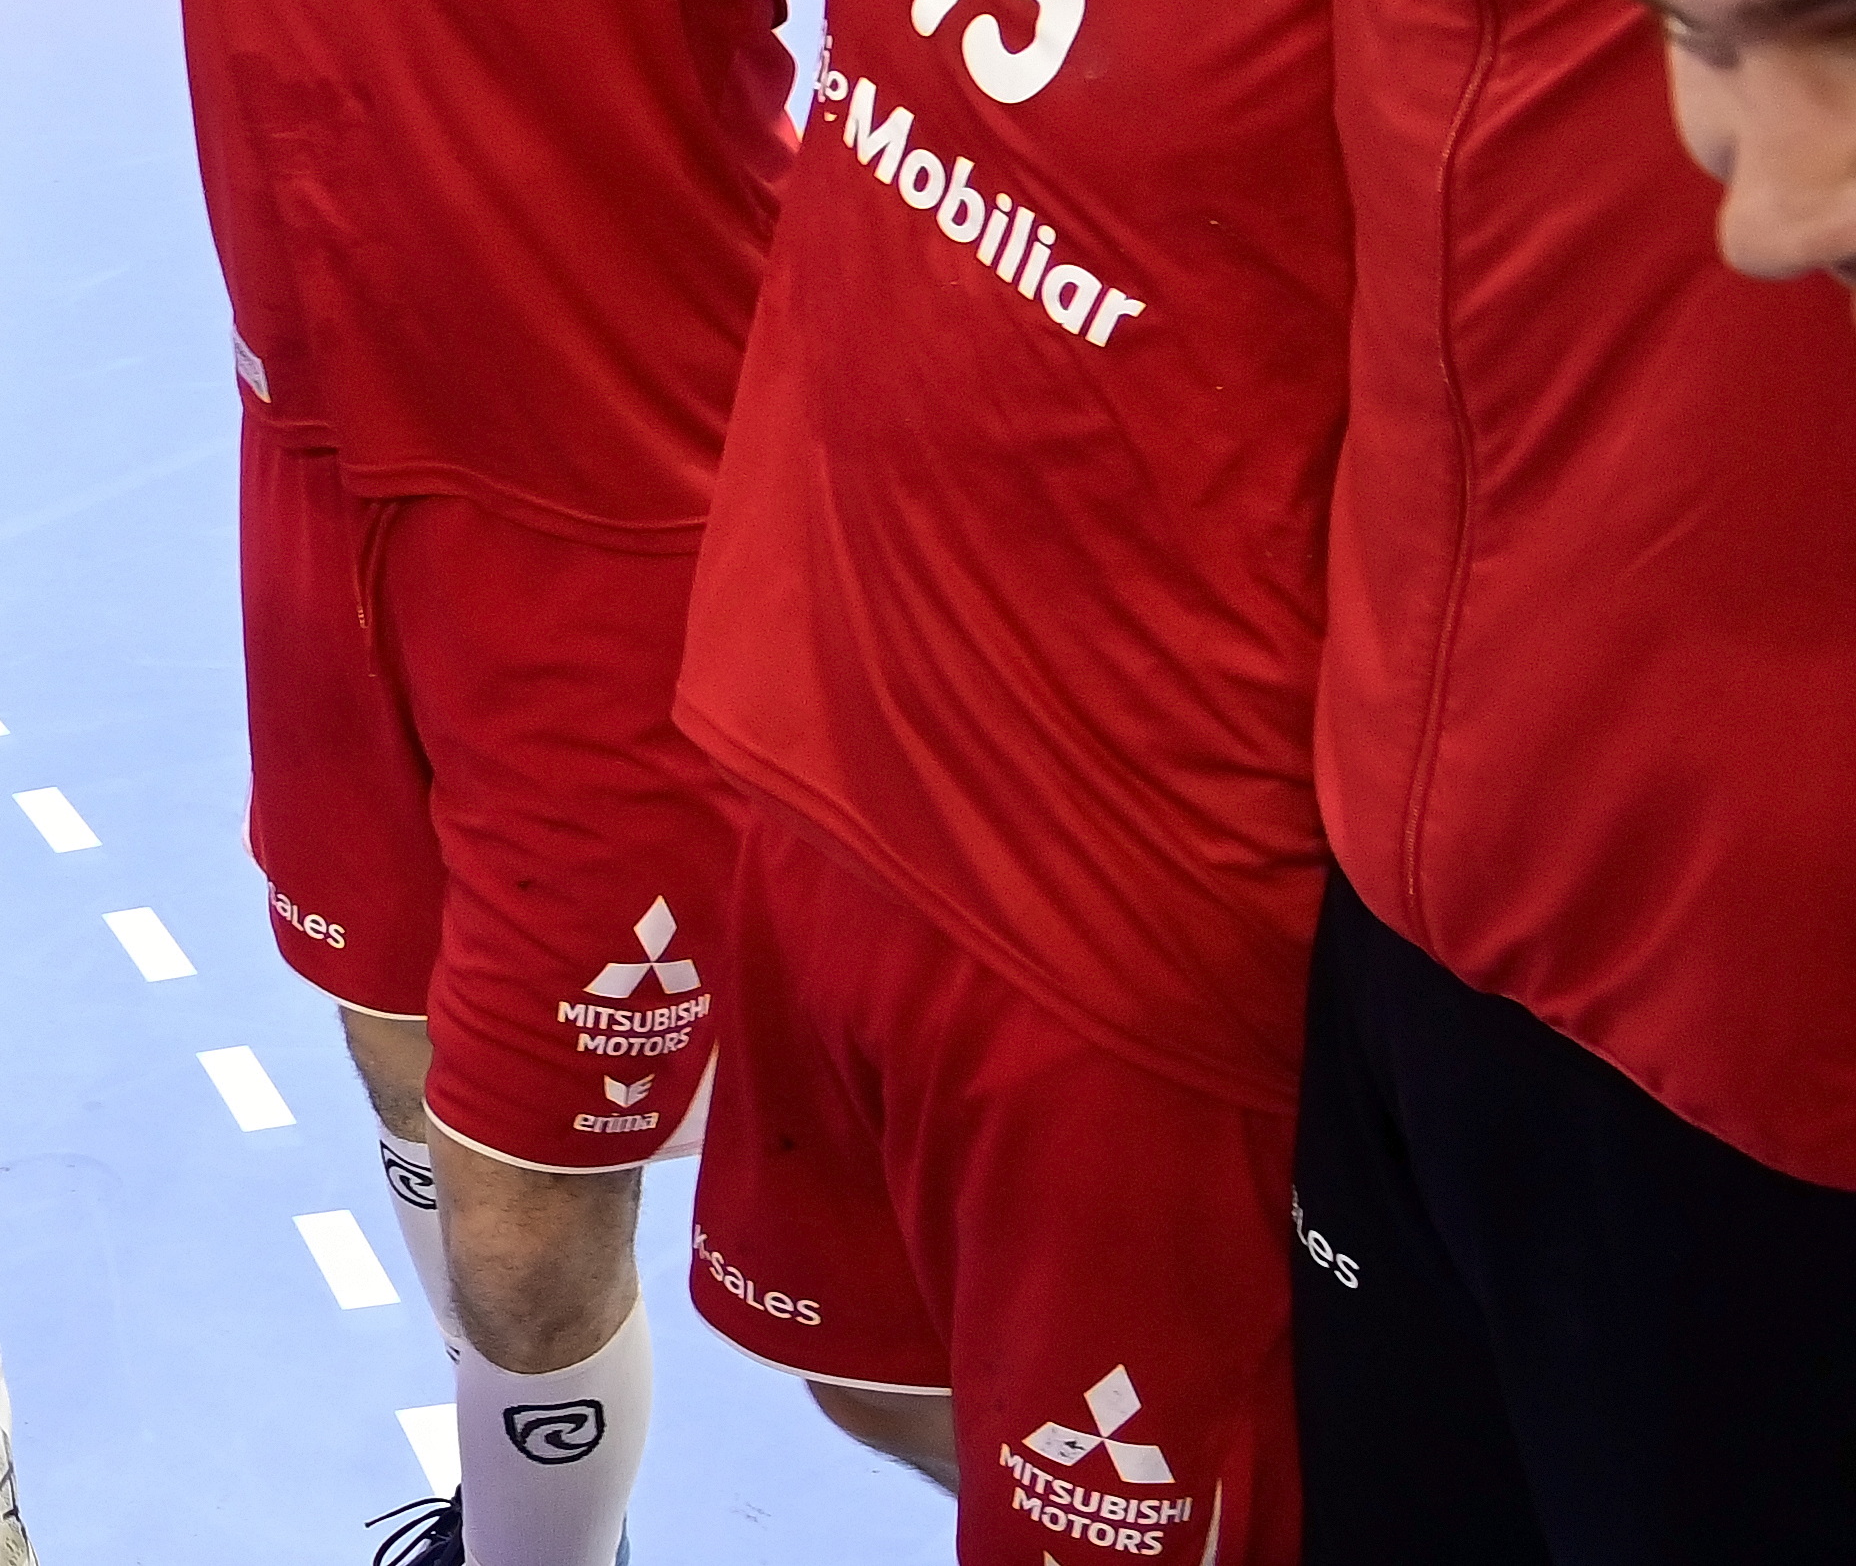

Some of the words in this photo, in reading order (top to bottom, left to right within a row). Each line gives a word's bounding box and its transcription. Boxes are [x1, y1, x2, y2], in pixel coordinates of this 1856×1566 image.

[843, 74, 1147, 348] Mobiliar
[557, 993, 712, 1033] MITSUBISHI
[576, 1026, 693, 1057] MOTORS
[573, 1112, 661, 1134] erima
[999, 1442, 1193, 1526] MITSUBISHI
[1011, 1486, 1165, 1557] MOTORS
